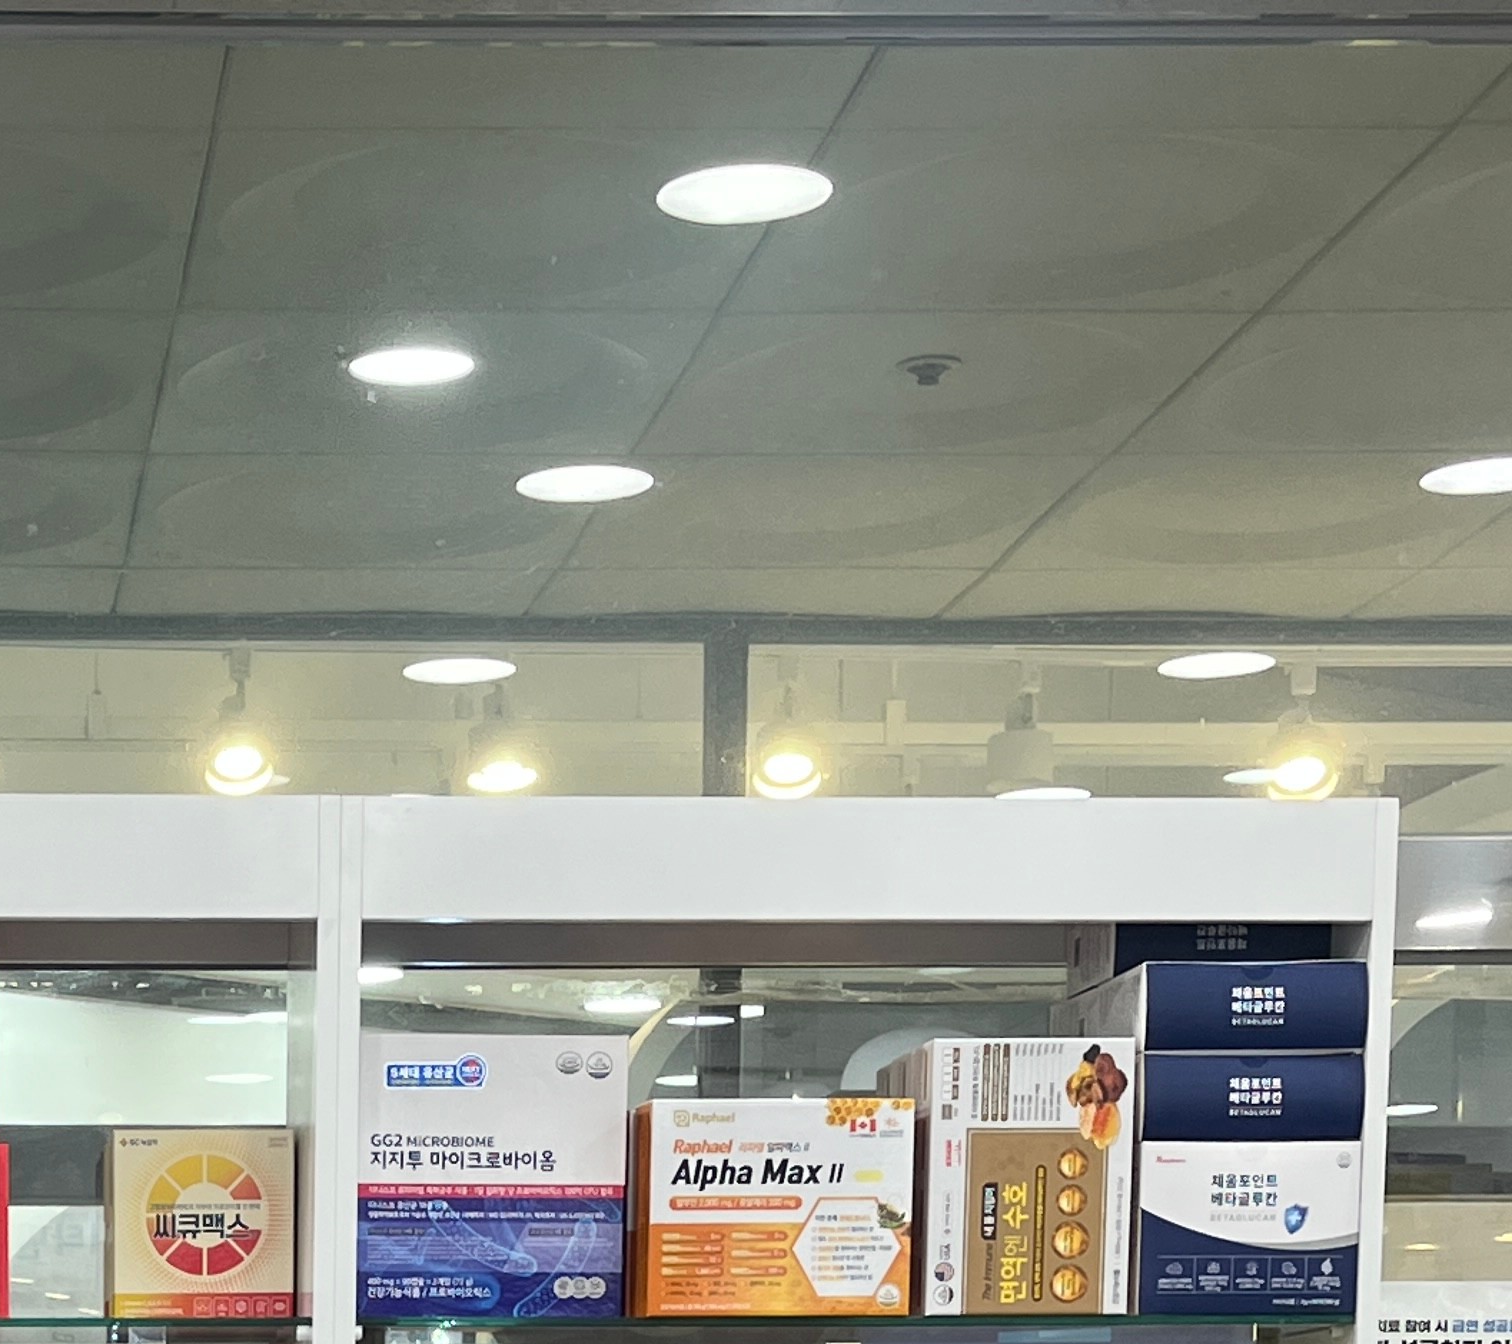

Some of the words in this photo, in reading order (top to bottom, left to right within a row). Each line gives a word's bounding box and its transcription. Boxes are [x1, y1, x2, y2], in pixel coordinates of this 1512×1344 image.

[692, 1111, 736, 1124] Raphael
[370, 1134, 403, 1148] GG2
[407, 1136, 494, 1148] MICROBIOME
[673, 1138, 733, 1156] Raphael
[370, 1151, 423, 1170] 지지투
[430, 1151, 557, 1172] 마이크로바이옴
[672, 1158, 753, 1190] Alpha
[760, 1160, 823, 1185] Max
[1002, 1181, 1029, 1230] 수호
[152, 1213, 251, 1241] 씨큐맥스
[1435, 1319, 1448, 1333] 시
[1452, 1320, 1479, 1333] 금연
